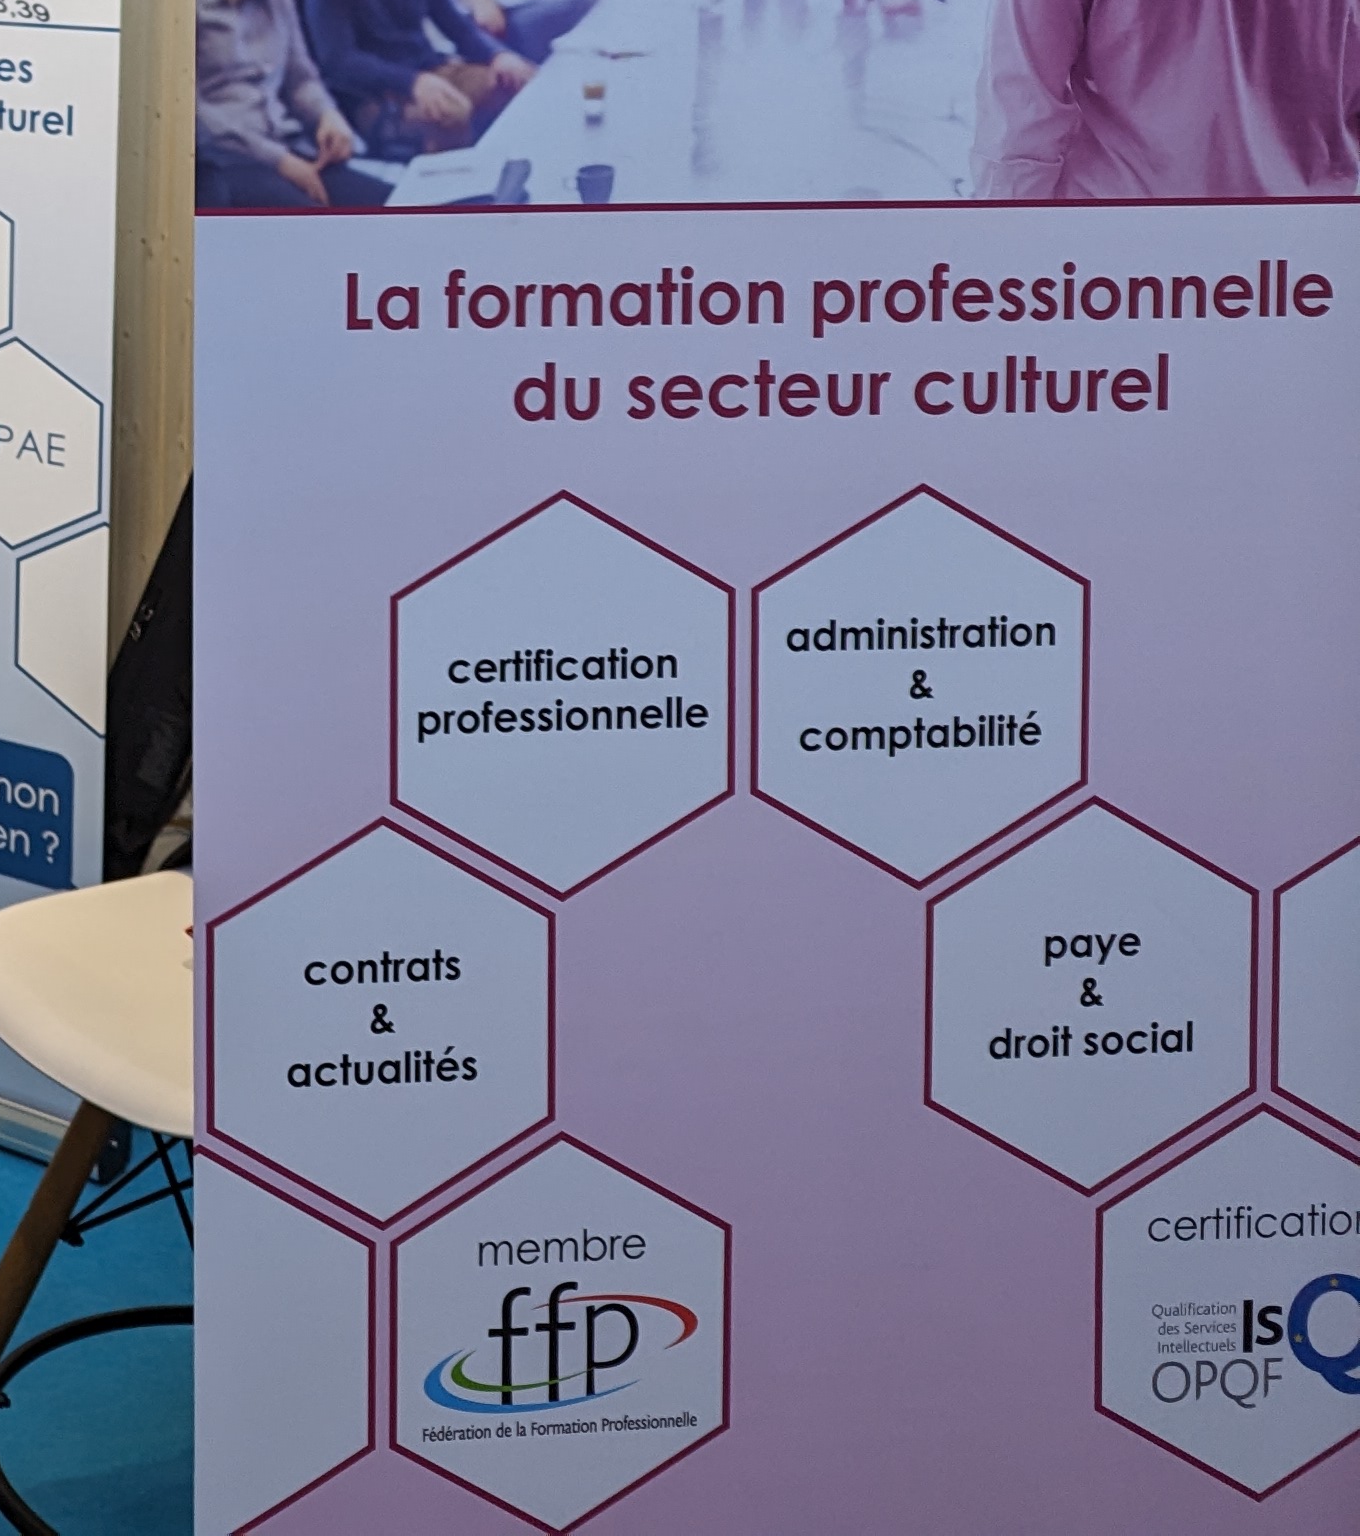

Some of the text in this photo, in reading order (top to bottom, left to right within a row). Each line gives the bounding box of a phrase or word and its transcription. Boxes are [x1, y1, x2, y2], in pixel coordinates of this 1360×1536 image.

[345, 258, 1334, 338] La formation professionnelle
[513, 352, 1170, 422] du secteur culturel
[785, 615, 1056, 654] administration
[447, 647, 679, 686] certification
[908, 669, 935, 700] &
[416, 695, 710, 743] professionnelle
[799, 712, 1042, 758] comptabilité
[42, 829, 60, 865] ?
[303, 948, 462, 987] contrats
[1042, 929, 1141, 967] paye
[1079, 977, 1103, 1009] &
[369, 1003, 396, 1035] &
[988, 1020, 1194, 1062] droit social
[286, 1047, 479, 1090] actualités
[1147, 1202, 1360, 1242] certificatio
[478, 1228, 647, 1267] membre
[1151, 1302, 1237, 1320] Qualification
[1157, 1321, 1237, 1335] des Services
[488, 1281, 640, 1406] ffp
[1157, 1339, 1236, 1354] Intellectuels
[1152, 1357, 1284, 1409] OPQF
[422, 1411, 698, 1443] Fédération de la Formation Professionnelle
